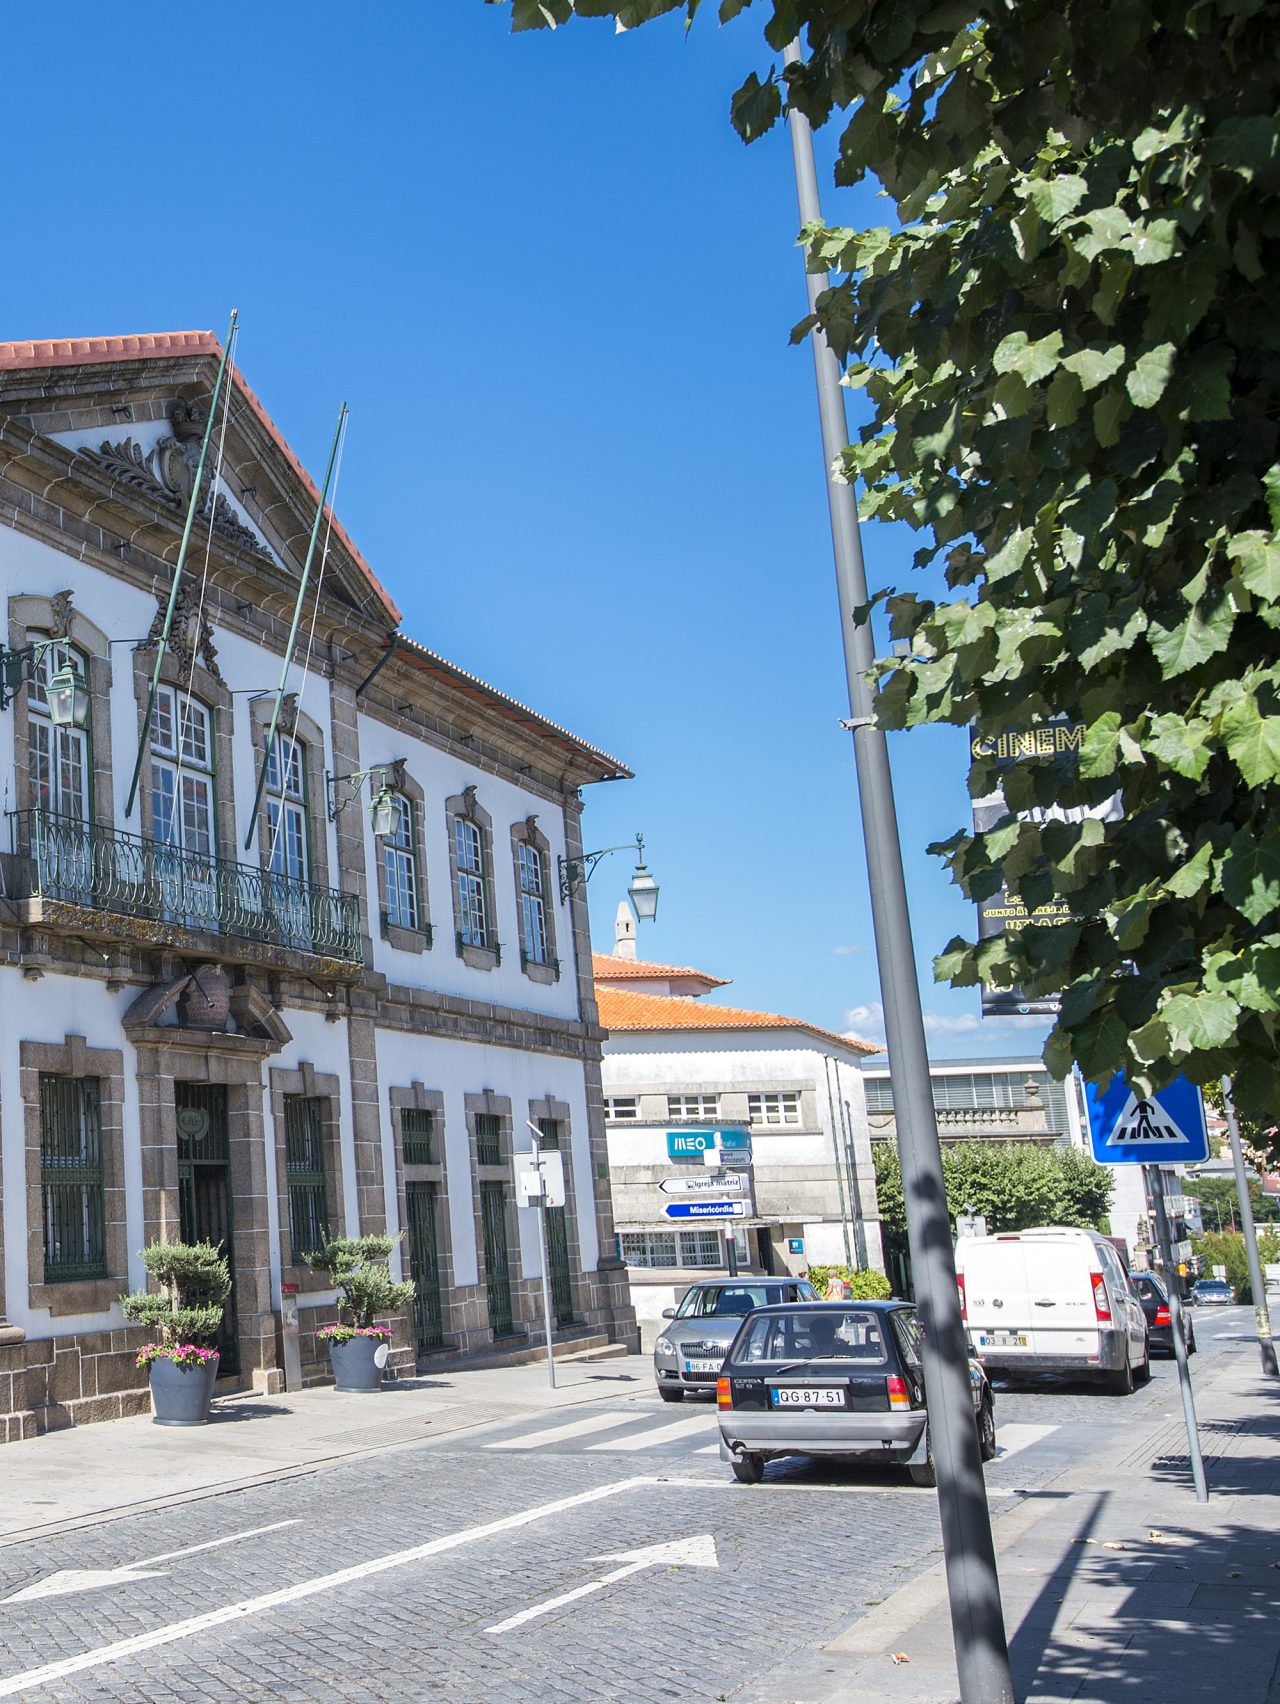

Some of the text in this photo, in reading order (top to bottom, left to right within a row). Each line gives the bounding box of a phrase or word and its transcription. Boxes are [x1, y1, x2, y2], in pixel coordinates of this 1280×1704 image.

[972, 724, 1087, 759] CINEM
[674, 1137, 706, 1150] MEO
[690, 1205, 734, 1214] Misericórdia
